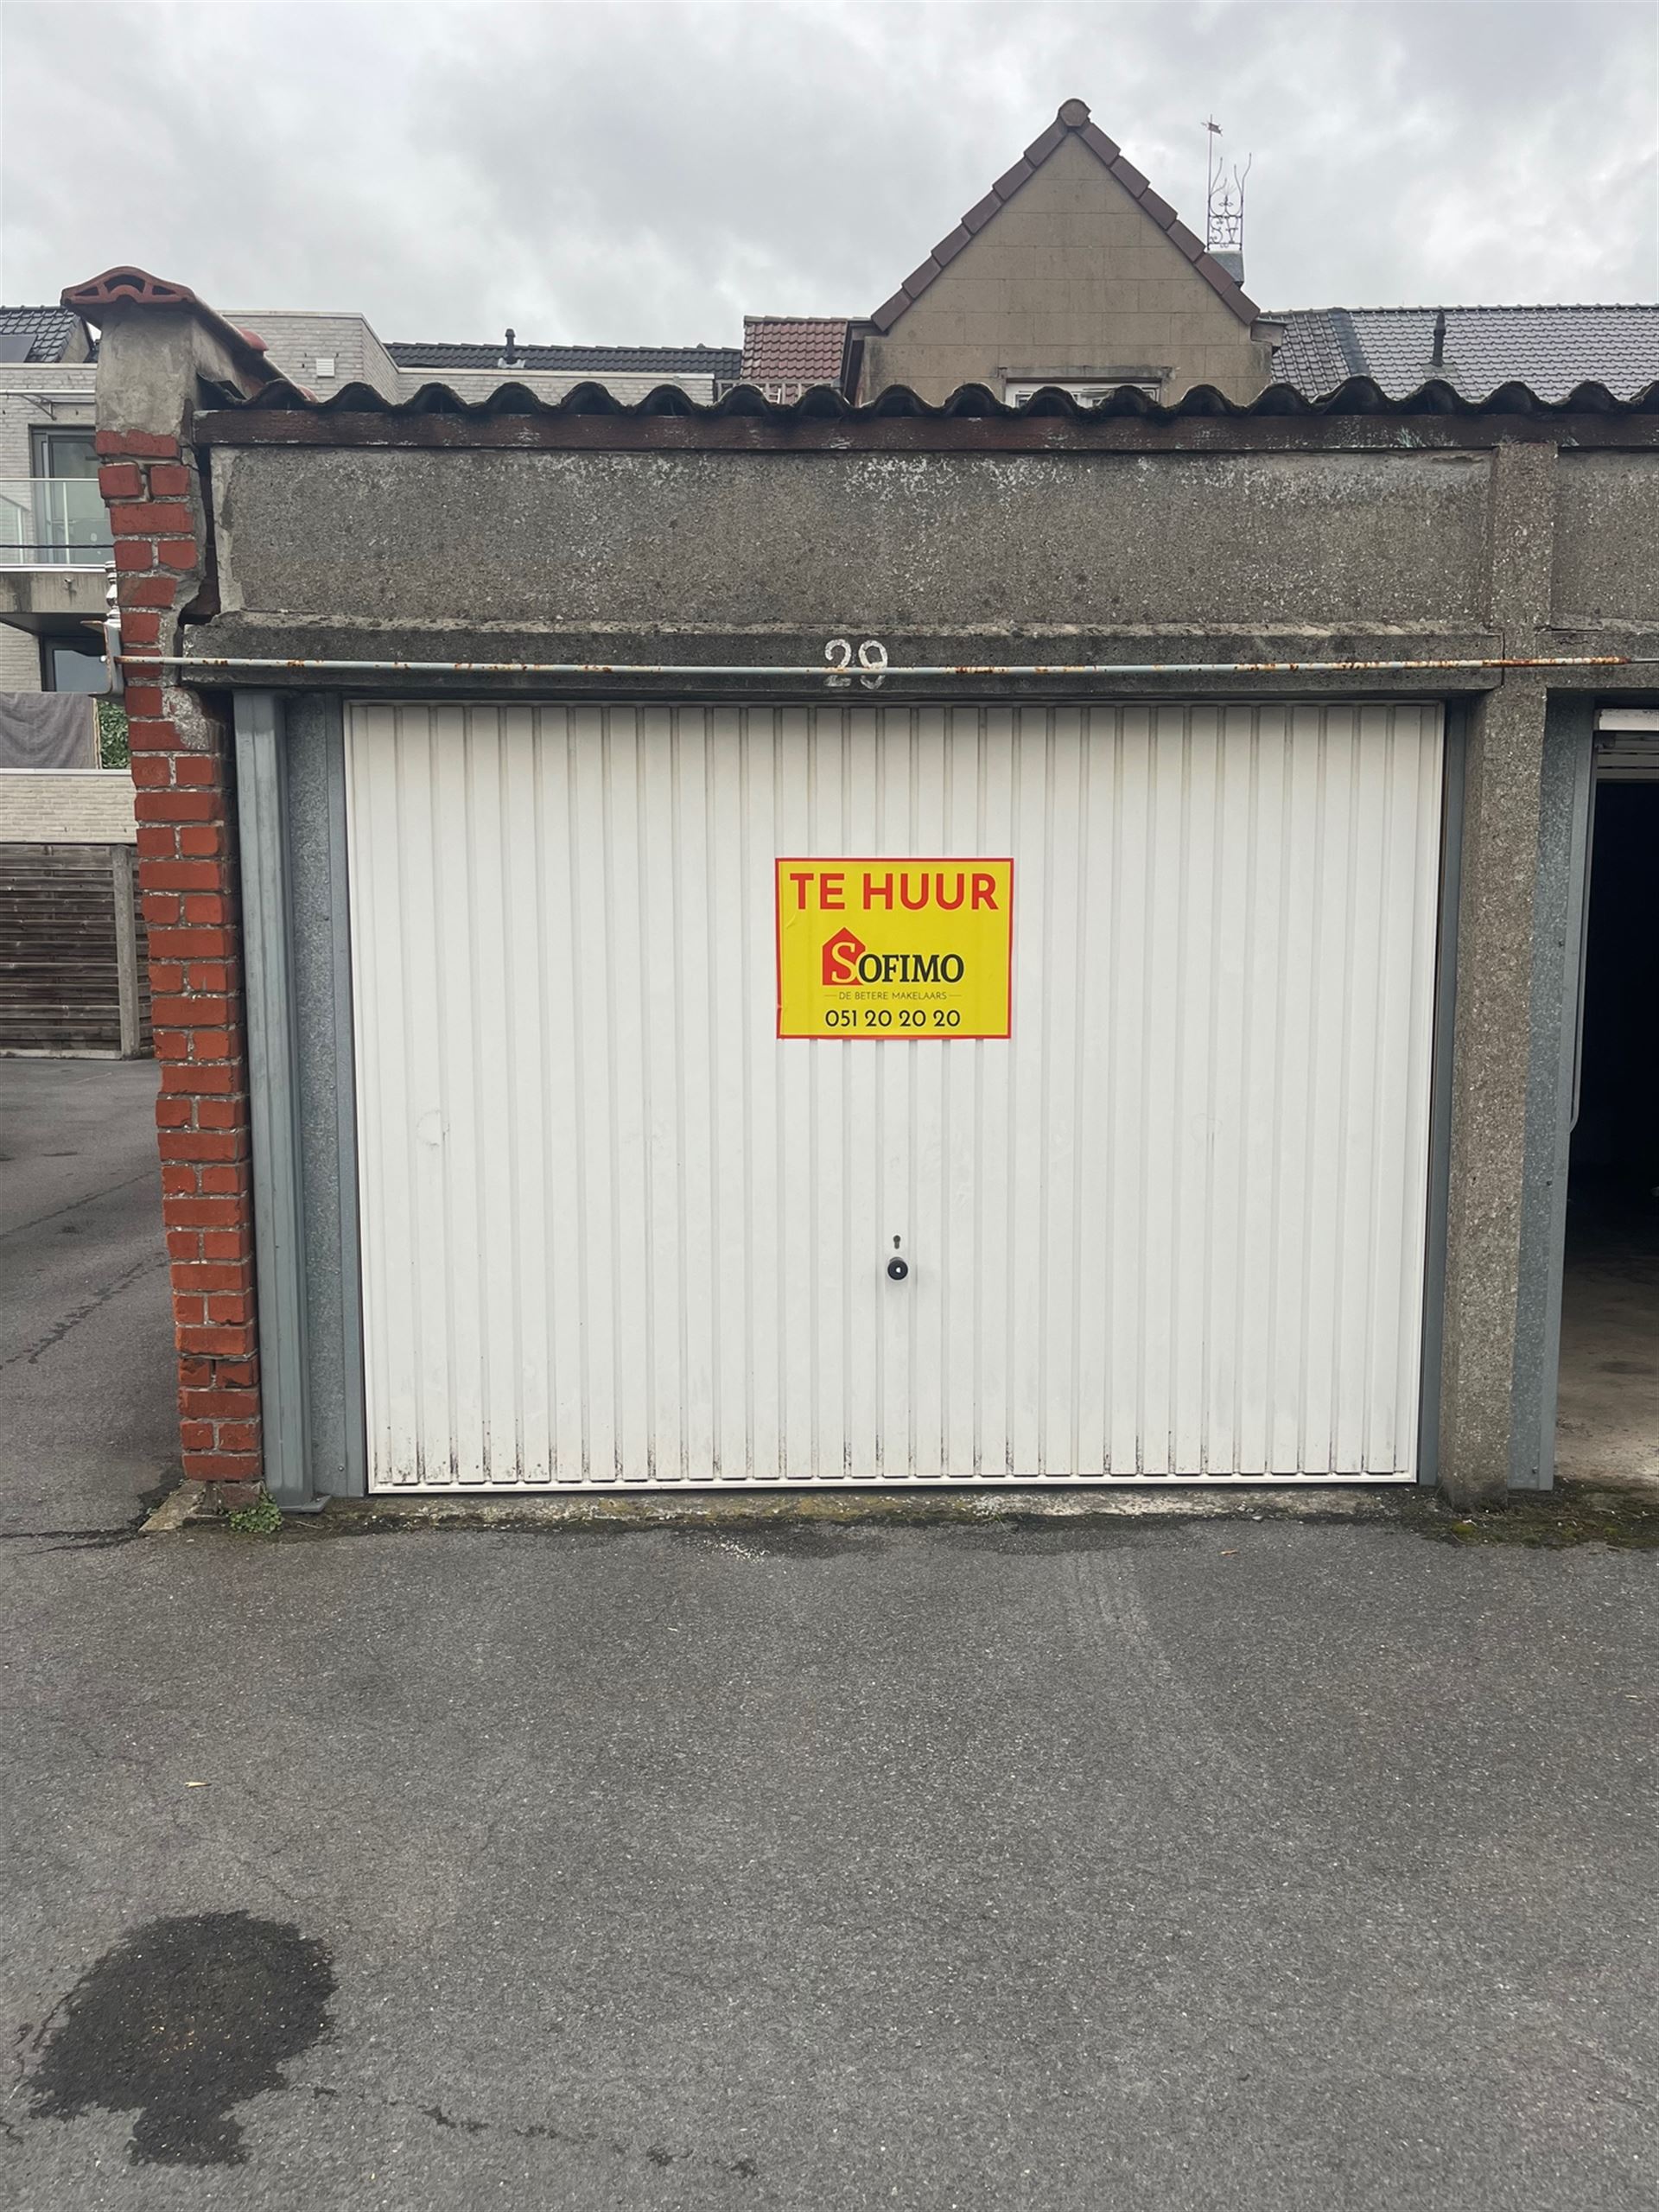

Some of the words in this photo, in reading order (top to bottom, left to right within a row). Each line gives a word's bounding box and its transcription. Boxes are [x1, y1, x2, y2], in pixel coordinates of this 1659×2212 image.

[790, 873, 845, 910] TE
[862, 873, 999, 910] HUUR
[830, 941, 964, 983] SOFIMO
[838, 991, 852, 1001] DE
[855, 991, 888, 1001] BETERE
[892, 991, 947, 1001] MAKELAARS
[825, 1009, 857, 1027] 051
[864, 1009, 892, 1027] 20
[899, 1009, 926, 1027] 20
[933, 1009, 961, 1027] 20
